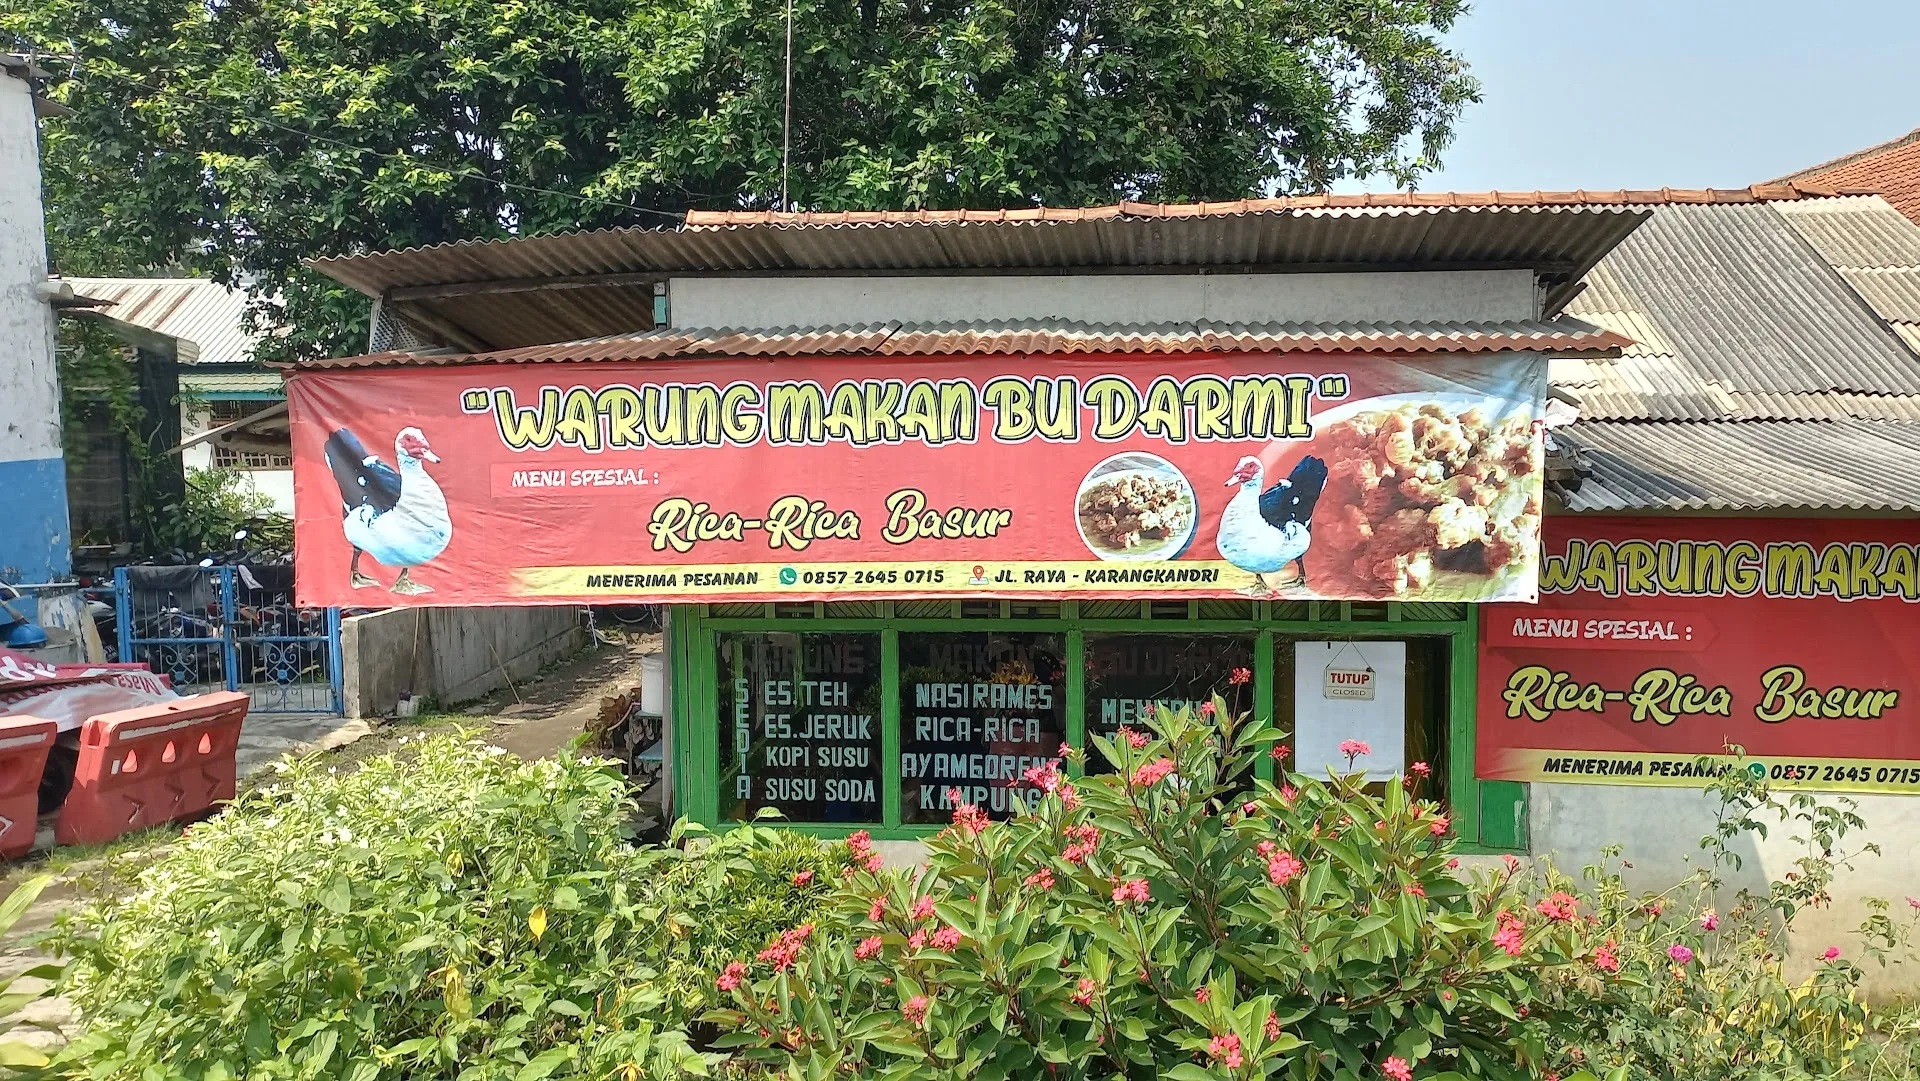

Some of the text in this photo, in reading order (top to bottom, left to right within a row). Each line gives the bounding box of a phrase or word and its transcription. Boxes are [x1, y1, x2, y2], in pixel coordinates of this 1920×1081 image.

[766, 377, 978, 448] MAKAN
[982, 375, 1079, 443] BU
[511, 468, 566, 487] MENU
[570, 468, 648, 486] SPESIAL
[647, 488, 1012, 553] Rica-Rica Basur
[586, 574, 678, 588] MENERIMA
[683, 572, 759, 587] PESANAN
[803, 571, 847, 585] 0857
[854, 570, 898, 584] 2645
[903, 569, 945, 583] 0715
[994, 570, 1018, 584] JL.
[1024, 569, 1067, 584] RAYA
[1084, 568, 1220, 583] KARANGKANDRI
[1763, 540, 1920, 603] MAKA
[1512, 617, 1579, 639] MENU
[1583, 618, 1679, 641] SPESIAL
[1331, 672, 1370, 684] TUTUP
[1503, 664, 1900, 725] Rica-Rica Basur
[915, 716, 1040, 743] RICA-RICA
[766, 746, 869, 767] KOPI SUSU
[1543, 758, 1643, 776] MENERIMA
[1770, 764, 1819, 781] 0857
[1822, 765, 1872, 782] 2645
[1876, 768, 1920, 784] 0715
[766, 778, 876, 802] SUSU SODA
